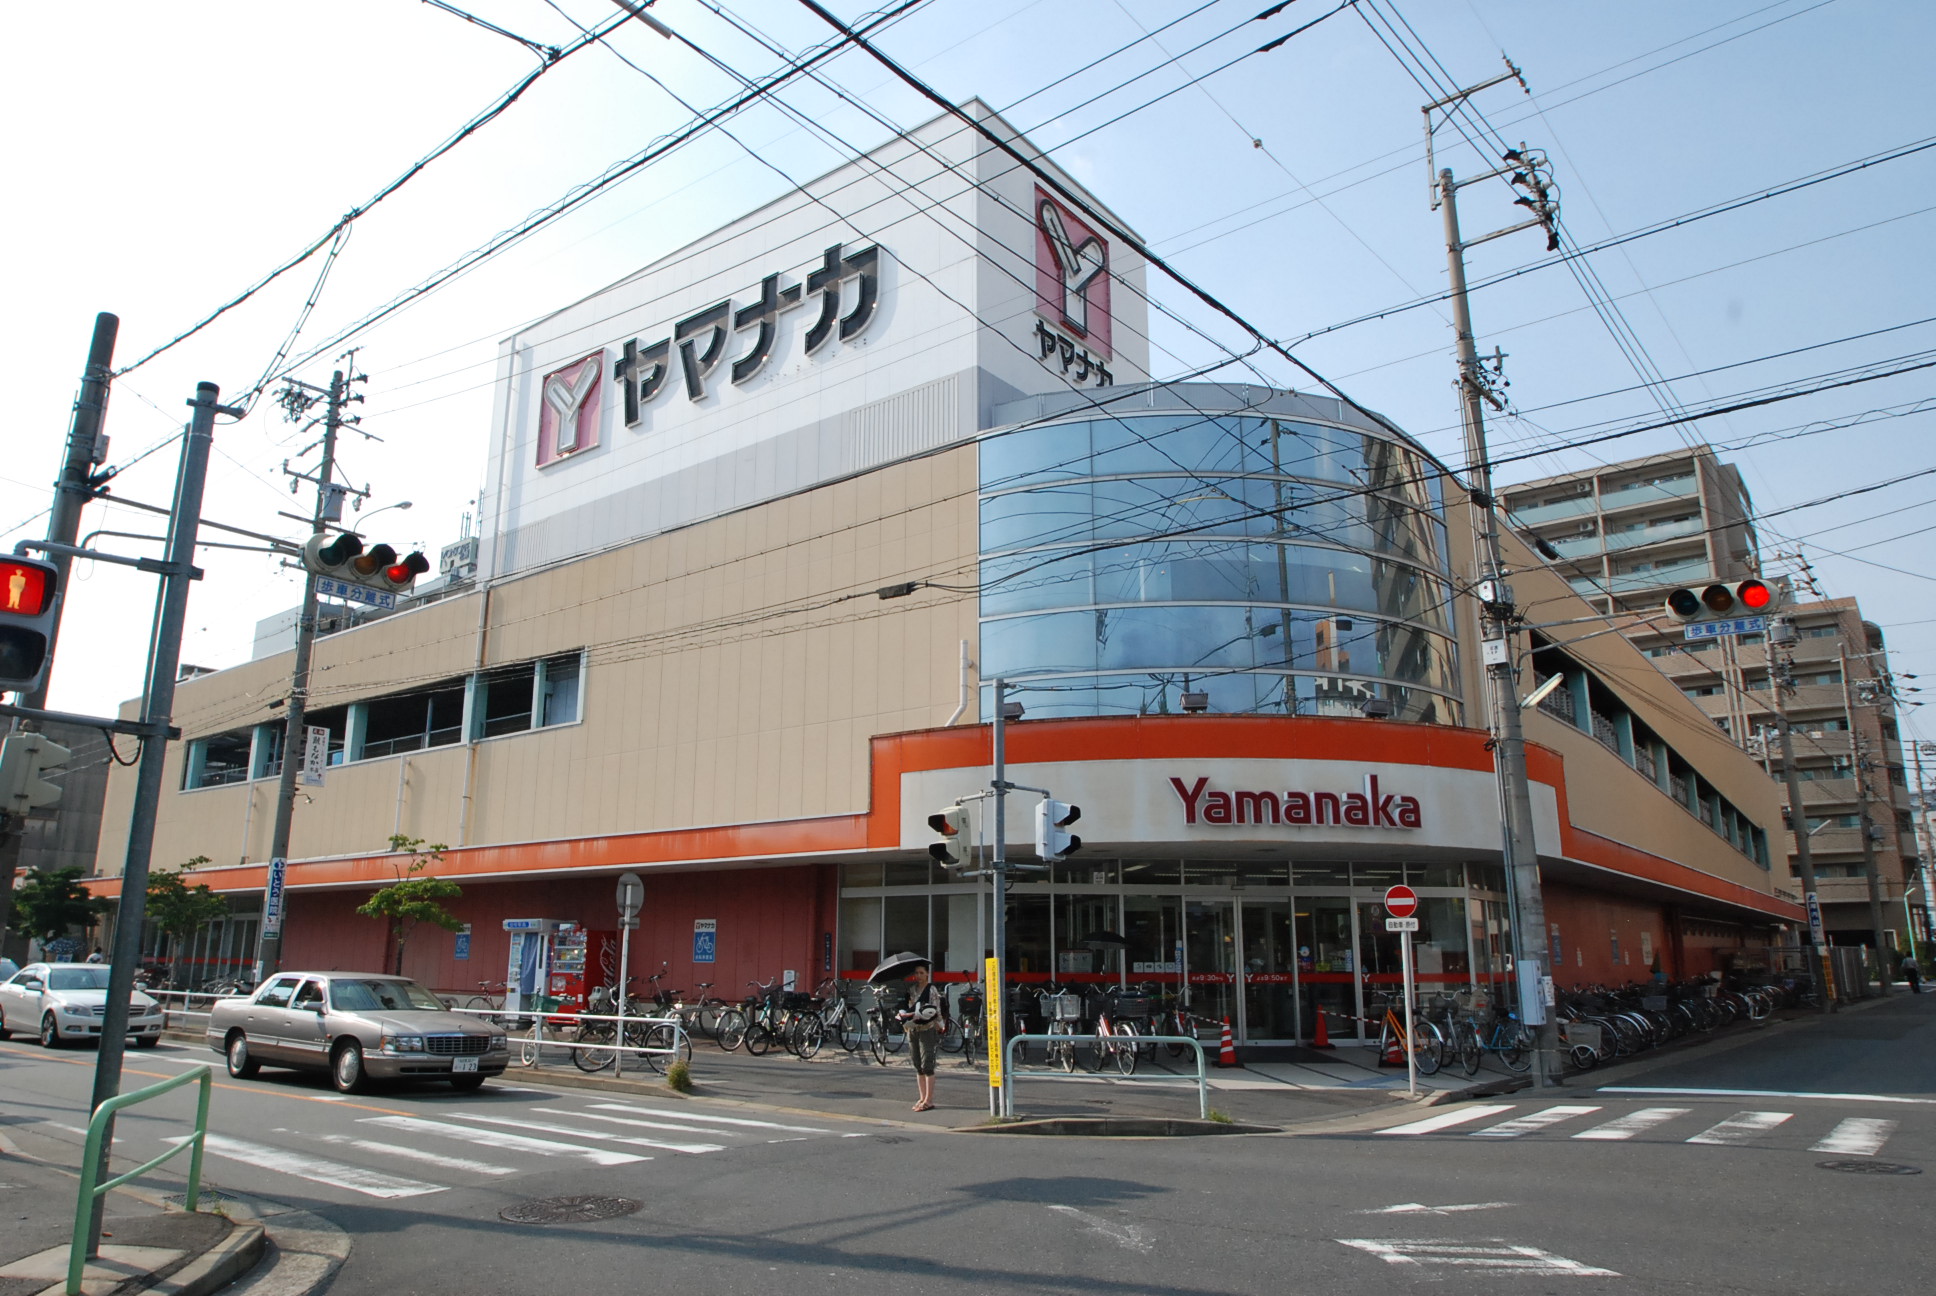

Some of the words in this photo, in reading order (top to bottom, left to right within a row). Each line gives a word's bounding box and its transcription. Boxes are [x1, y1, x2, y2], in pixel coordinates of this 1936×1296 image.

[614, 243, 880, 428] ヤマナカ
[1035, 319, 1114, 387] ヤマナカ
[321, 580, 391, 607] 歩車分離式
[1691, 618, 1762, 636] 歩車分離式
[1168, 774, 1422, 829] Yamanaka
